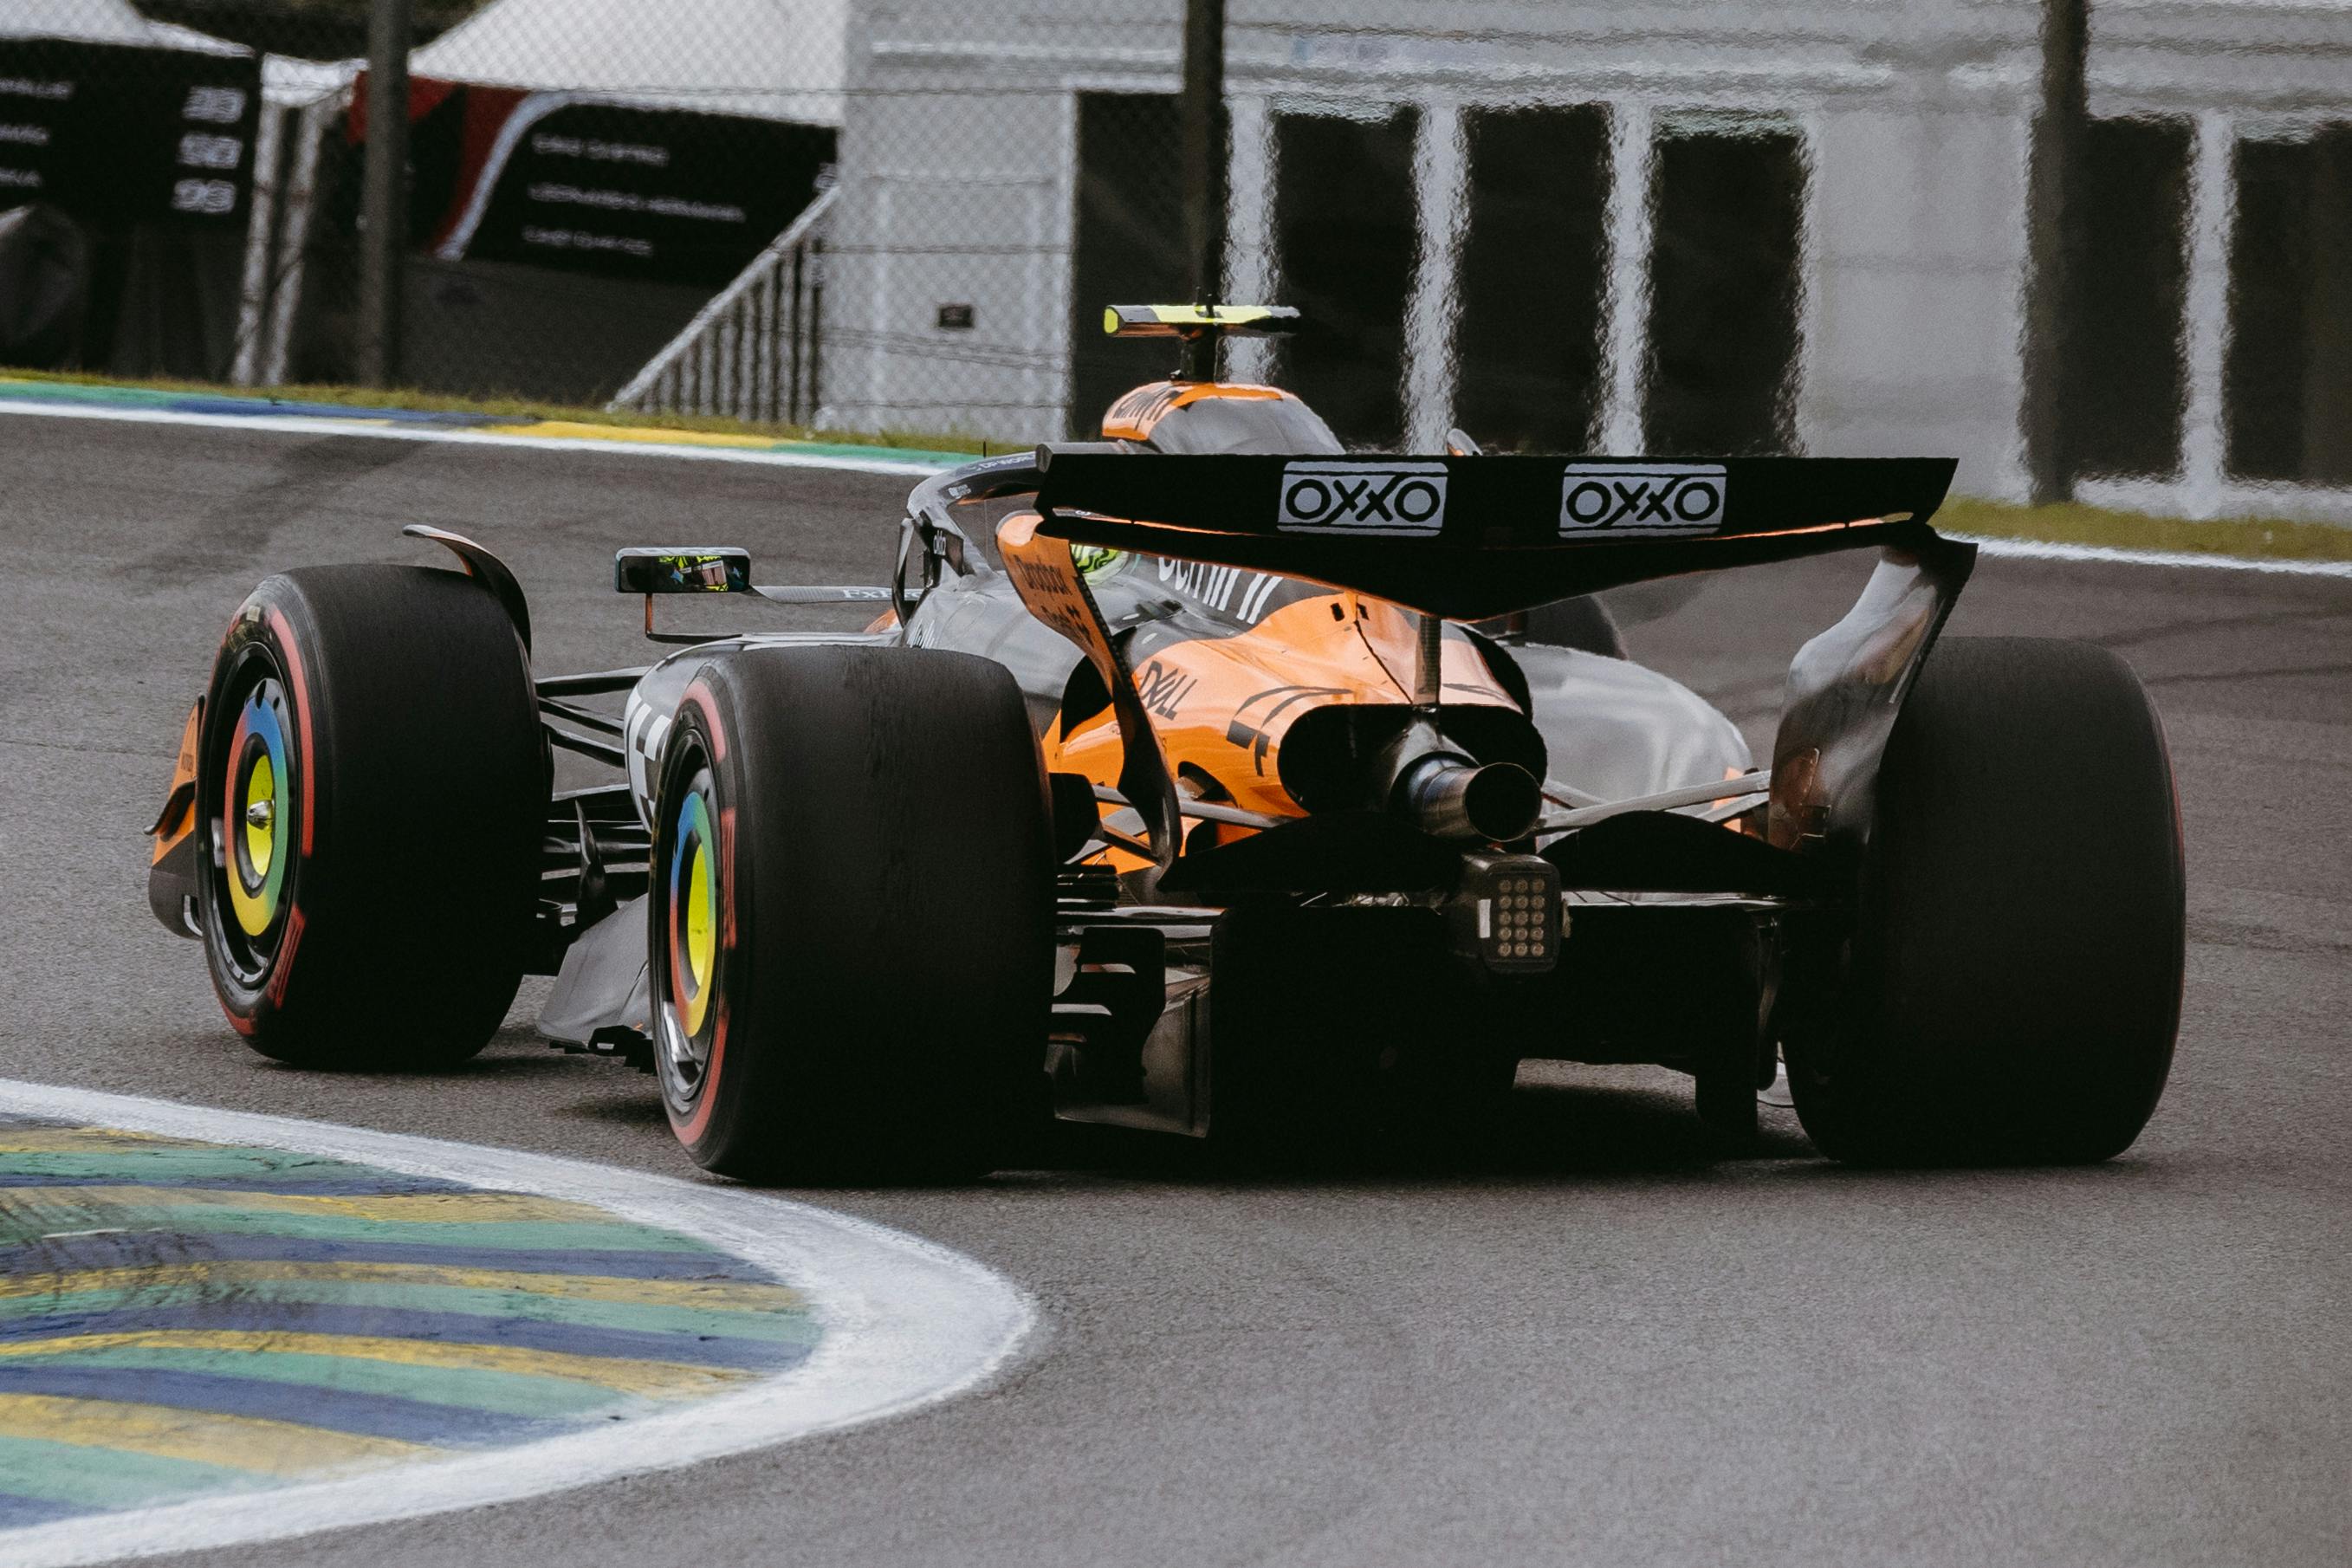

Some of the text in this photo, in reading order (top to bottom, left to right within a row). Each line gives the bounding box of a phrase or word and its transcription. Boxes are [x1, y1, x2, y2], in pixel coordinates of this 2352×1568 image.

[1285, 476, 1440, 523] OXXO
[1566, 479, 1720, 525] OXXO
[1138, 660, 1198, 721] DELL
